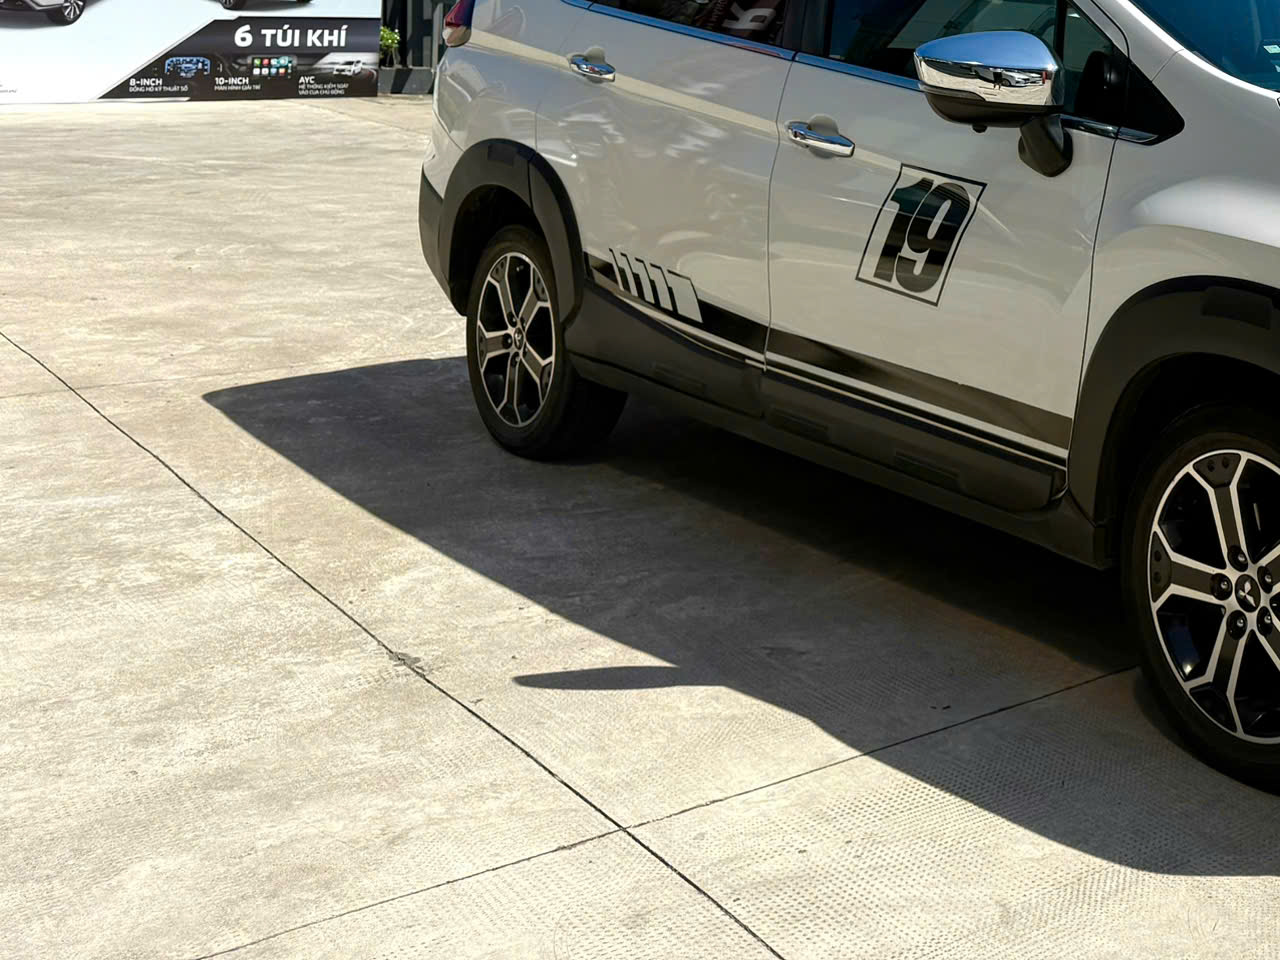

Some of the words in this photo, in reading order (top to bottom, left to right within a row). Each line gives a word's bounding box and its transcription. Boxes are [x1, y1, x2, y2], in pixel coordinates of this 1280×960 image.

[234, 25, 253, 47] 6
[261, 25, 299, 47] TÚI
[307, 25, 349, 47] KHÍ
[129, 78, 163, 86] 8-INCH
[215, 77, 249, 85] 10-INCH
[873, 177, 970, 293] 19
